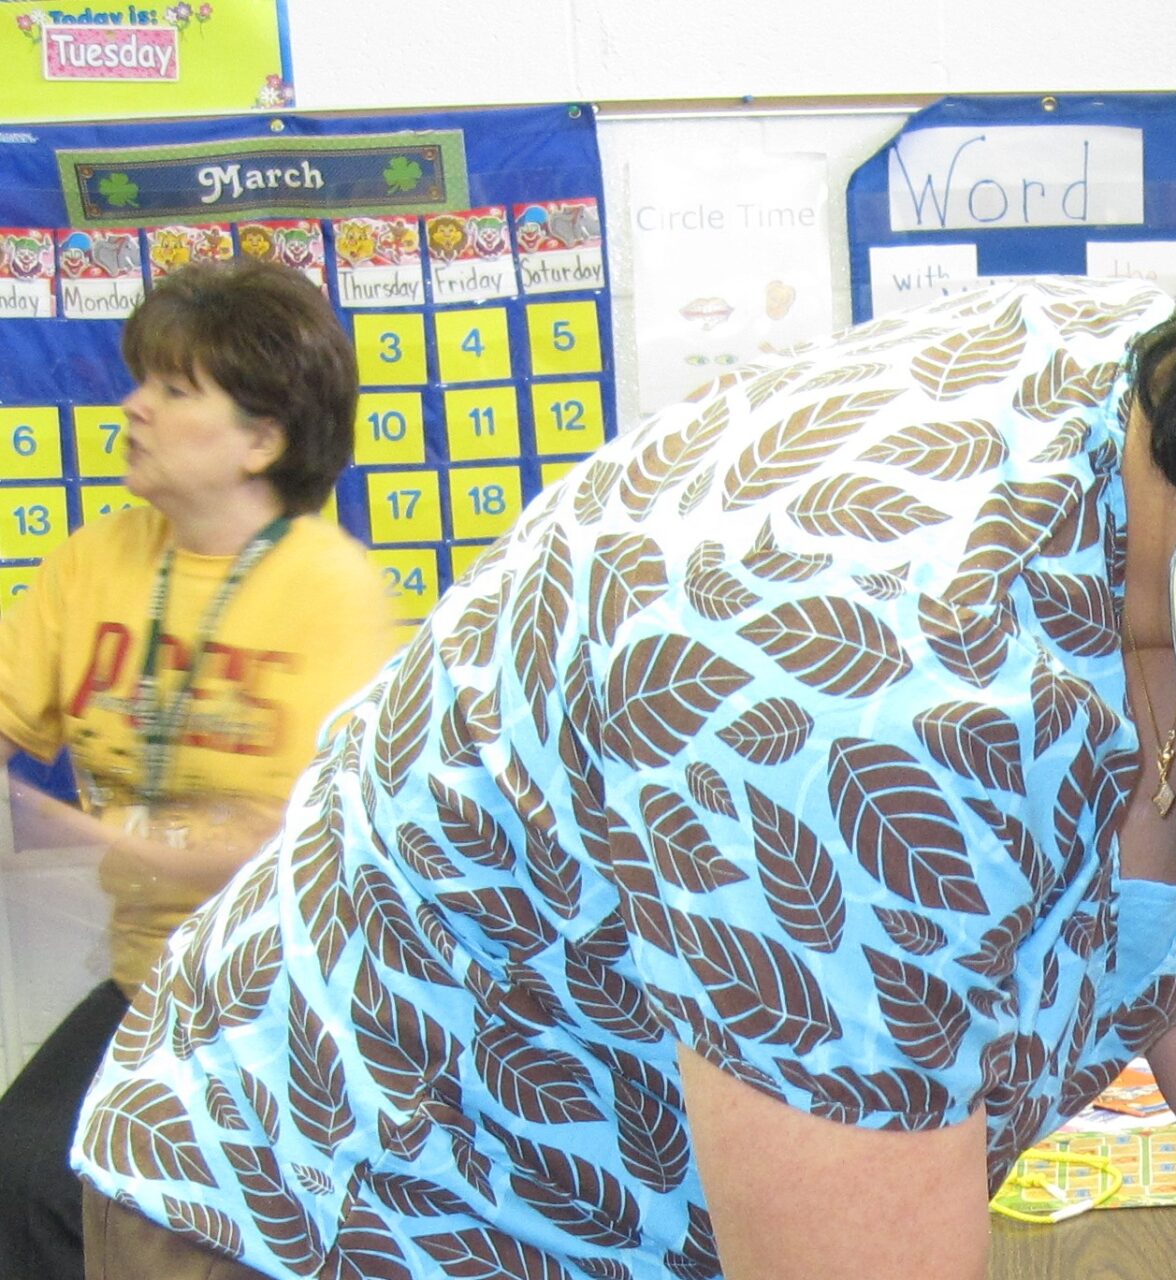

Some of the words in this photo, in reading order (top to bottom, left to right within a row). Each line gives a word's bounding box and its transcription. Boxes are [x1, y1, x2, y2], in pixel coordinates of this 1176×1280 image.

[48, 8, 123, 26] Today
[128, 6, 158, 25] is:
[50, 34, 173, 77] Tuesday
[198, 160, 325, 204] March
[892, 134, 1090, 228] Word
[636, 204, 725, 232] Circle
[736, 203, 816, 229] Time
[339, 270, 418, 301] Thursday
[435, 266, 502, 294] Friday
[521, 253, 602, 288] Saturday
[892, 263, 950, 291] with
[63, 282, 143, 312] Monday
[379, 332, 402, 363] 3
[461, 328, 485, 358] 4
[552, 320, 576, 351] 5
[367, 411, 407, 441] 10
[469, 407, 495, 437] 11
[550, 400, 586, 431] 12
[12, 425, 37, 456] 6
[99, 424, 121, 454] 7
[387, 489, 422, 520] 17
[468, 485, 506, 516] 18
[13, 505, 51, 535] 13
[382, 567, 427, 596] 24
